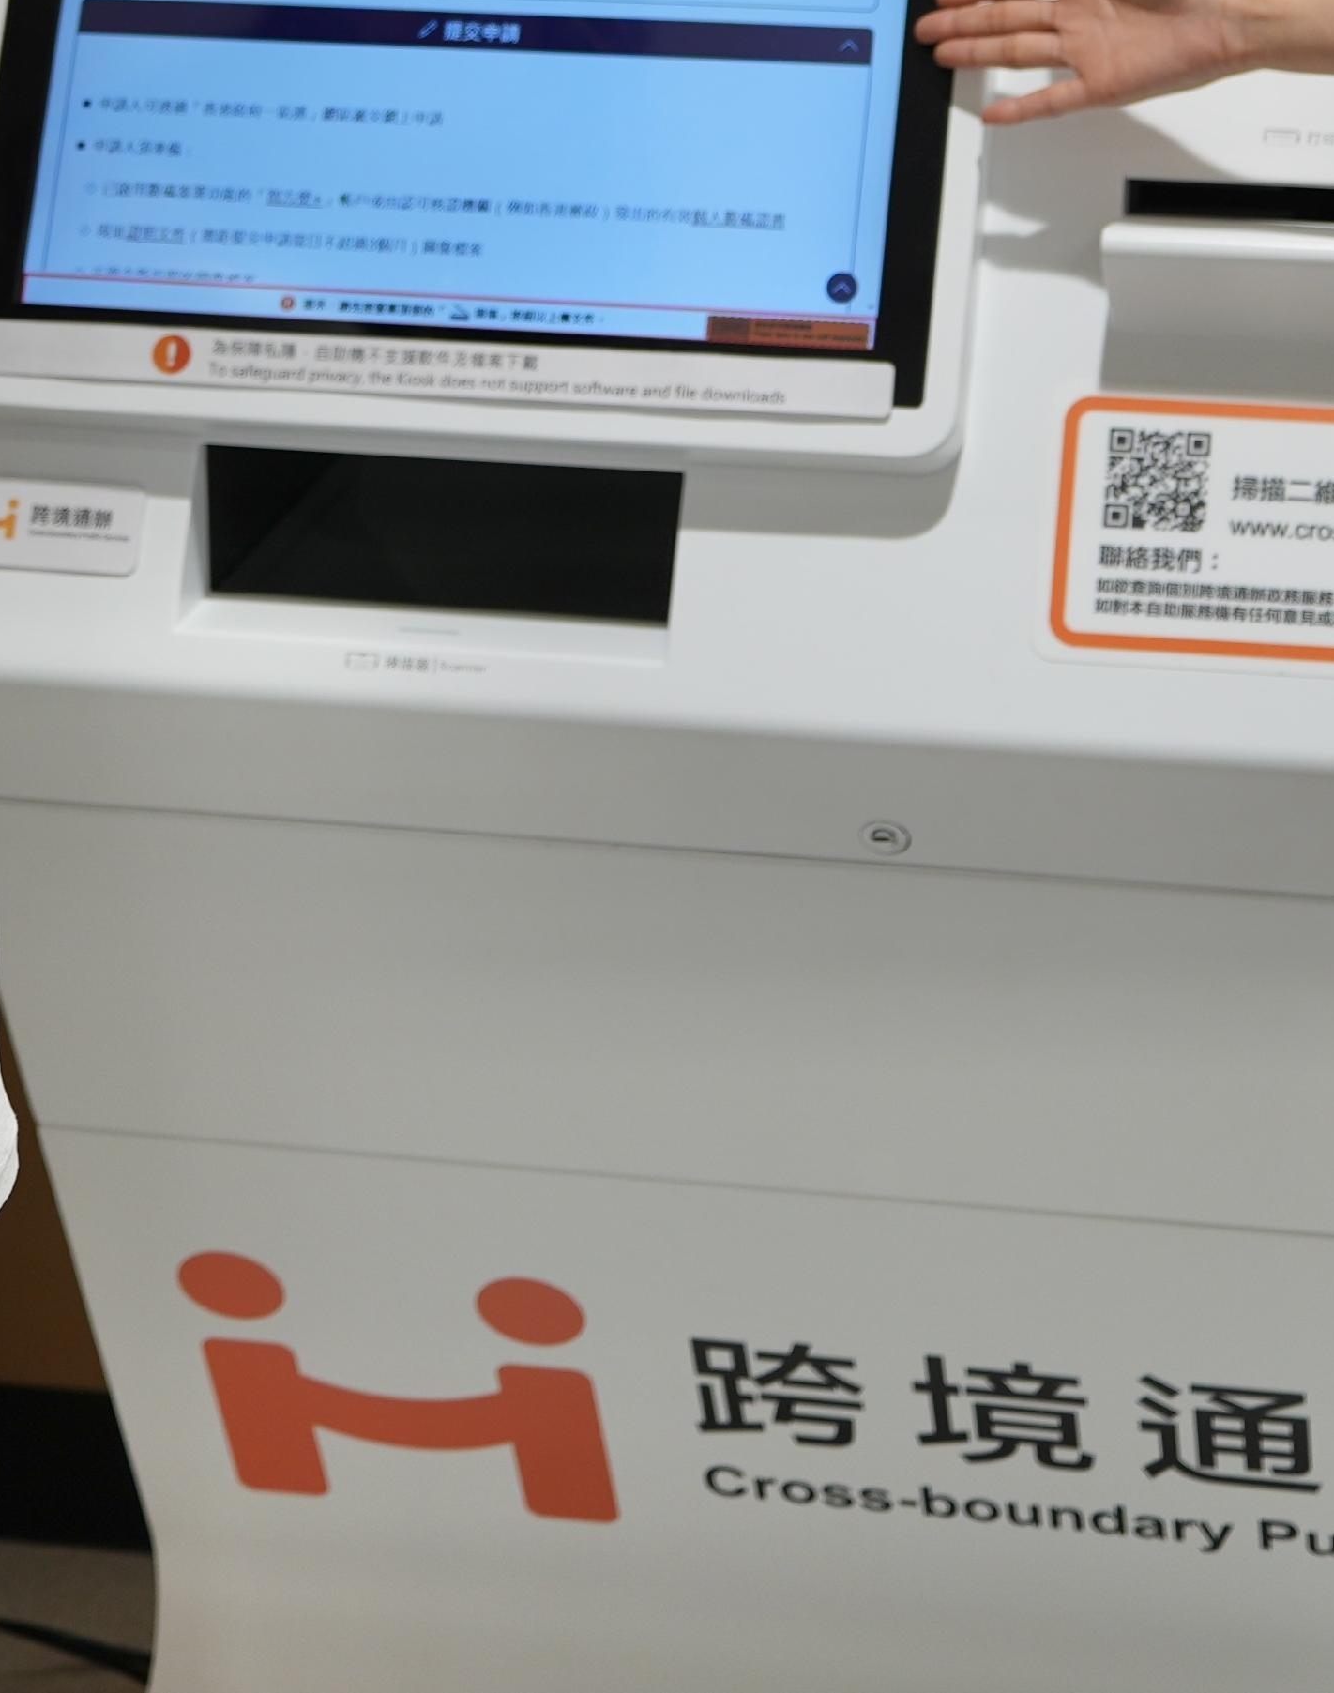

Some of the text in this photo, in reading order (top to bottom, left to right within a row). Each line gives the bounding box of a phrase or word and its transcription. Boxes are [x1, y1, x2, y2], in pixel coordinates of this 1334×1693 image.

[209, 362, 227, 377] To
[231, 363, 306, 383] safeguard
[370, 369, 391, 385] the
[442, 374, 475, 389] does
[481, 377, 505, 390] not
[509, 379, 569, 396] support
[573, 381, 637, 399] software
[643, 384, 671, 399] and
[674, 385, 697, 400] file
[703, 1463, 1235, 1554] Cross-boundary
